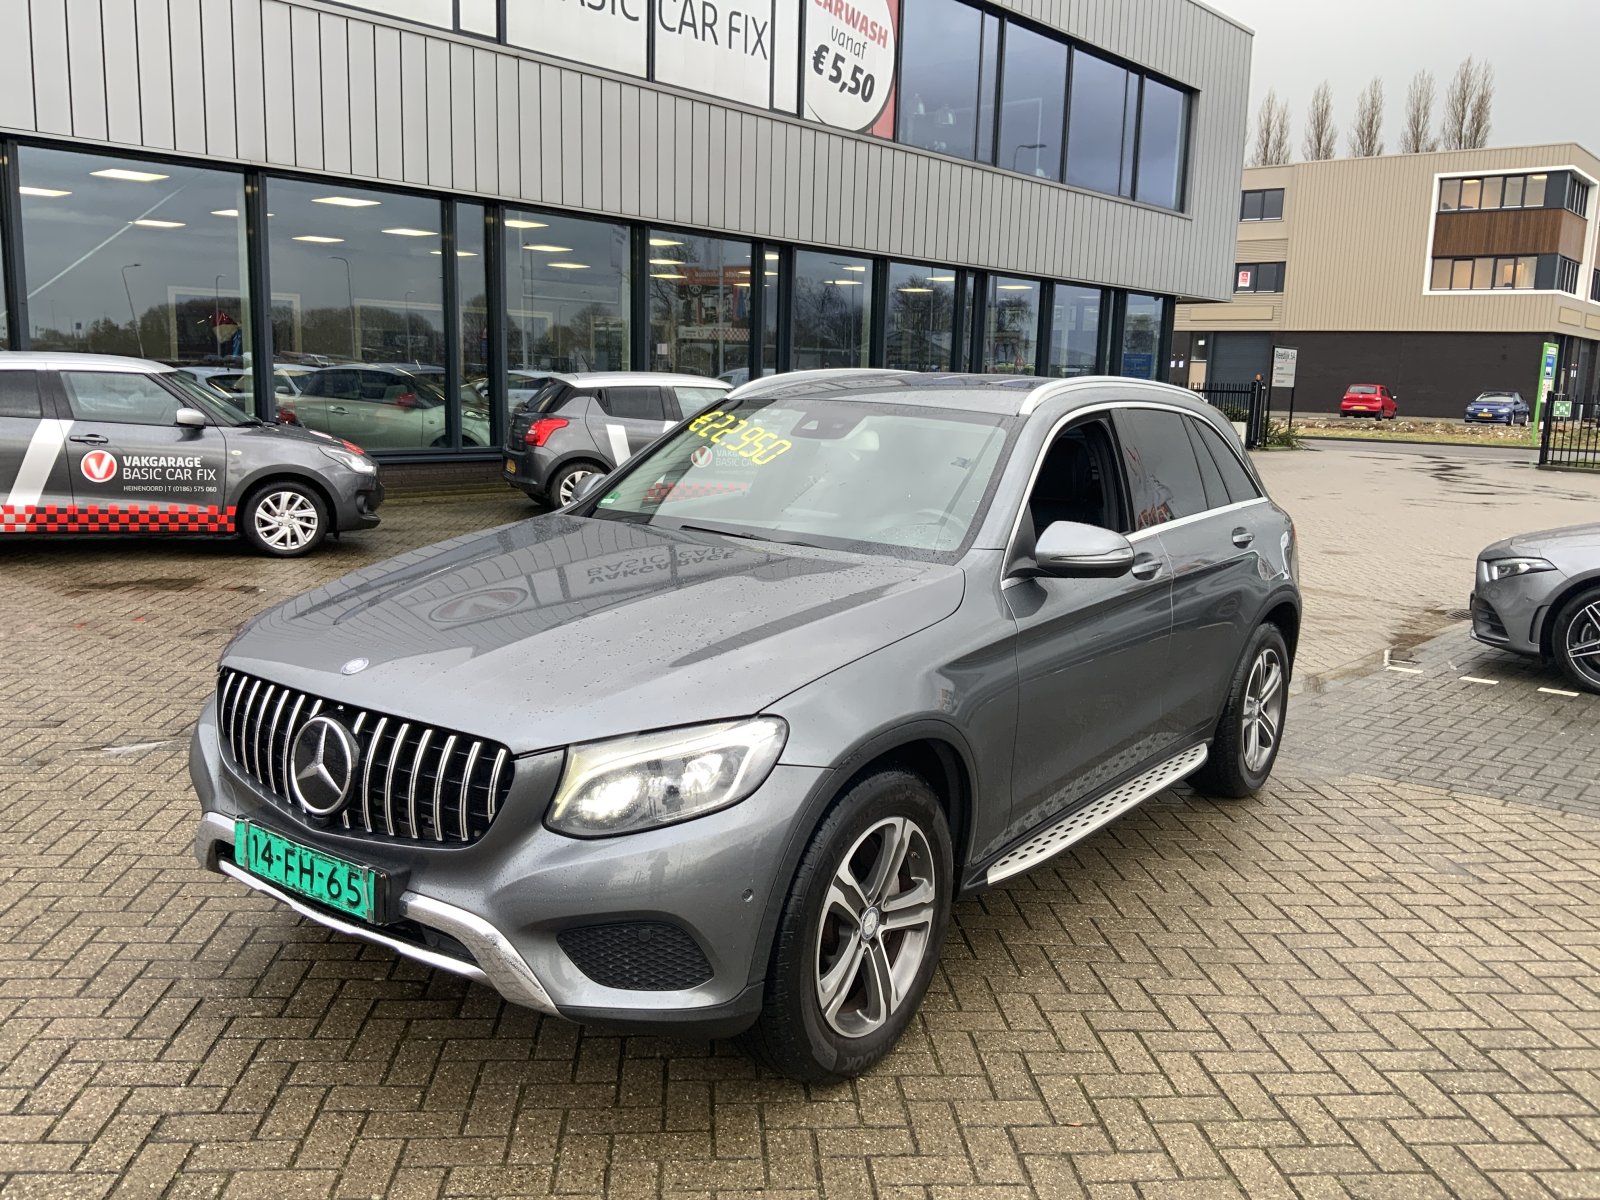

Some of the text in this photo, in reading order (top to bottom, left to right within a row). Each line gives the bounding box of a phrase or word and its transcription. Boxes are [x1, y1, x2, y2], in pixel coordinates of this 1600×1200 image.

[658, 0, 719, 46] CAR
[728, 10, 768, 61] FIX
[831, 25, 867, 60] vanaf
[122, 455, 202, 468] VAKGARAGE
[122, 467, 217, 481] BASIC CAR FIX
[172, 485, 193, 494] (0186)
[193, 485, 205, 493] 575
[252, 834, 362, 908] 14-FH-65
